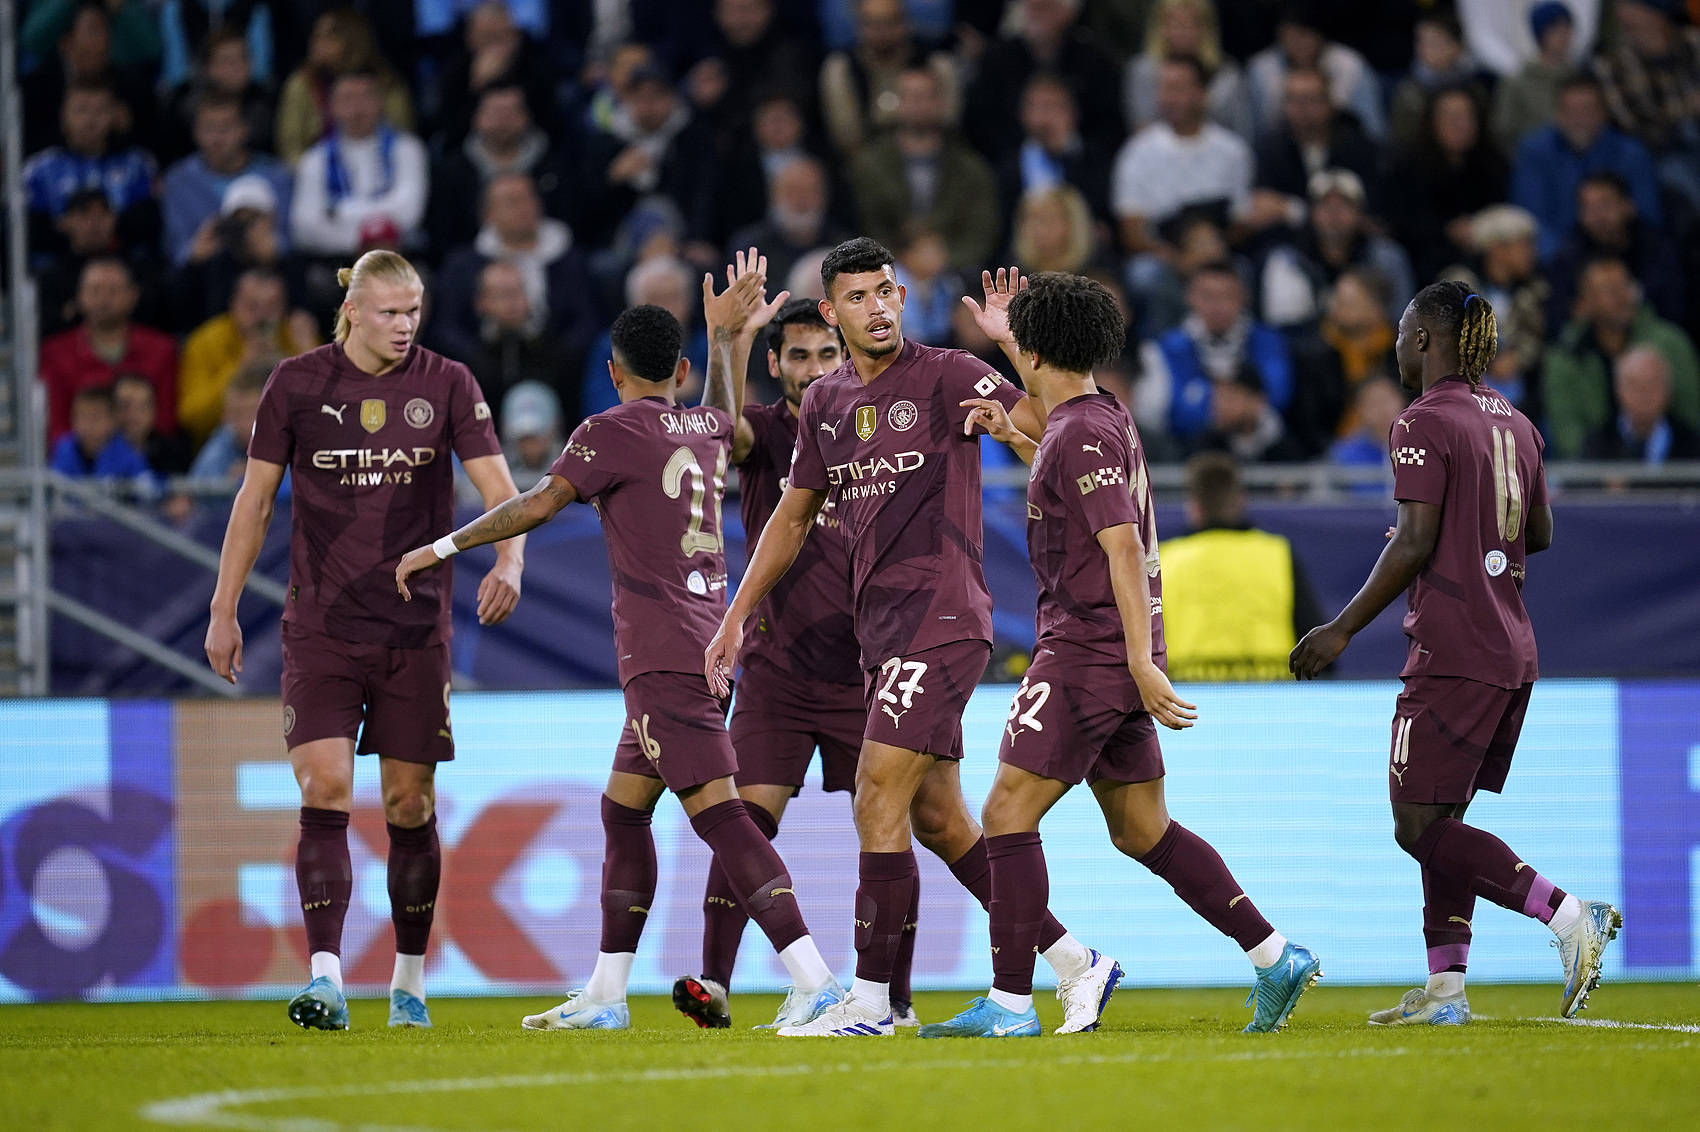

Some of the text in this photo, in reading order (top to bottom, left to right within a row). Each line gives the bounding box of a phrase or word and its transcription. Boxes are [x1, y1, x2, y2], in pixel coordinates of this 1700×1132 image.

[1471, 393, 1512, 417] DOKU
[659, 412, 719, 434] SAVINHO
[312, 447, 436, 470] ETIHAD
[827, 450, 925, 485] ETIHAD
[340, 471, 413, 486] AIRWAYS
[1492, 425, 1522, 543] 11
[841, 480, 897, 502] AIRWAYS
[877, 656, 928, 709] 27
[1393, 716, 1413, 765] 11
[707, 896, 736, 908] CITY
[854, 918, 871, 929] ITY
